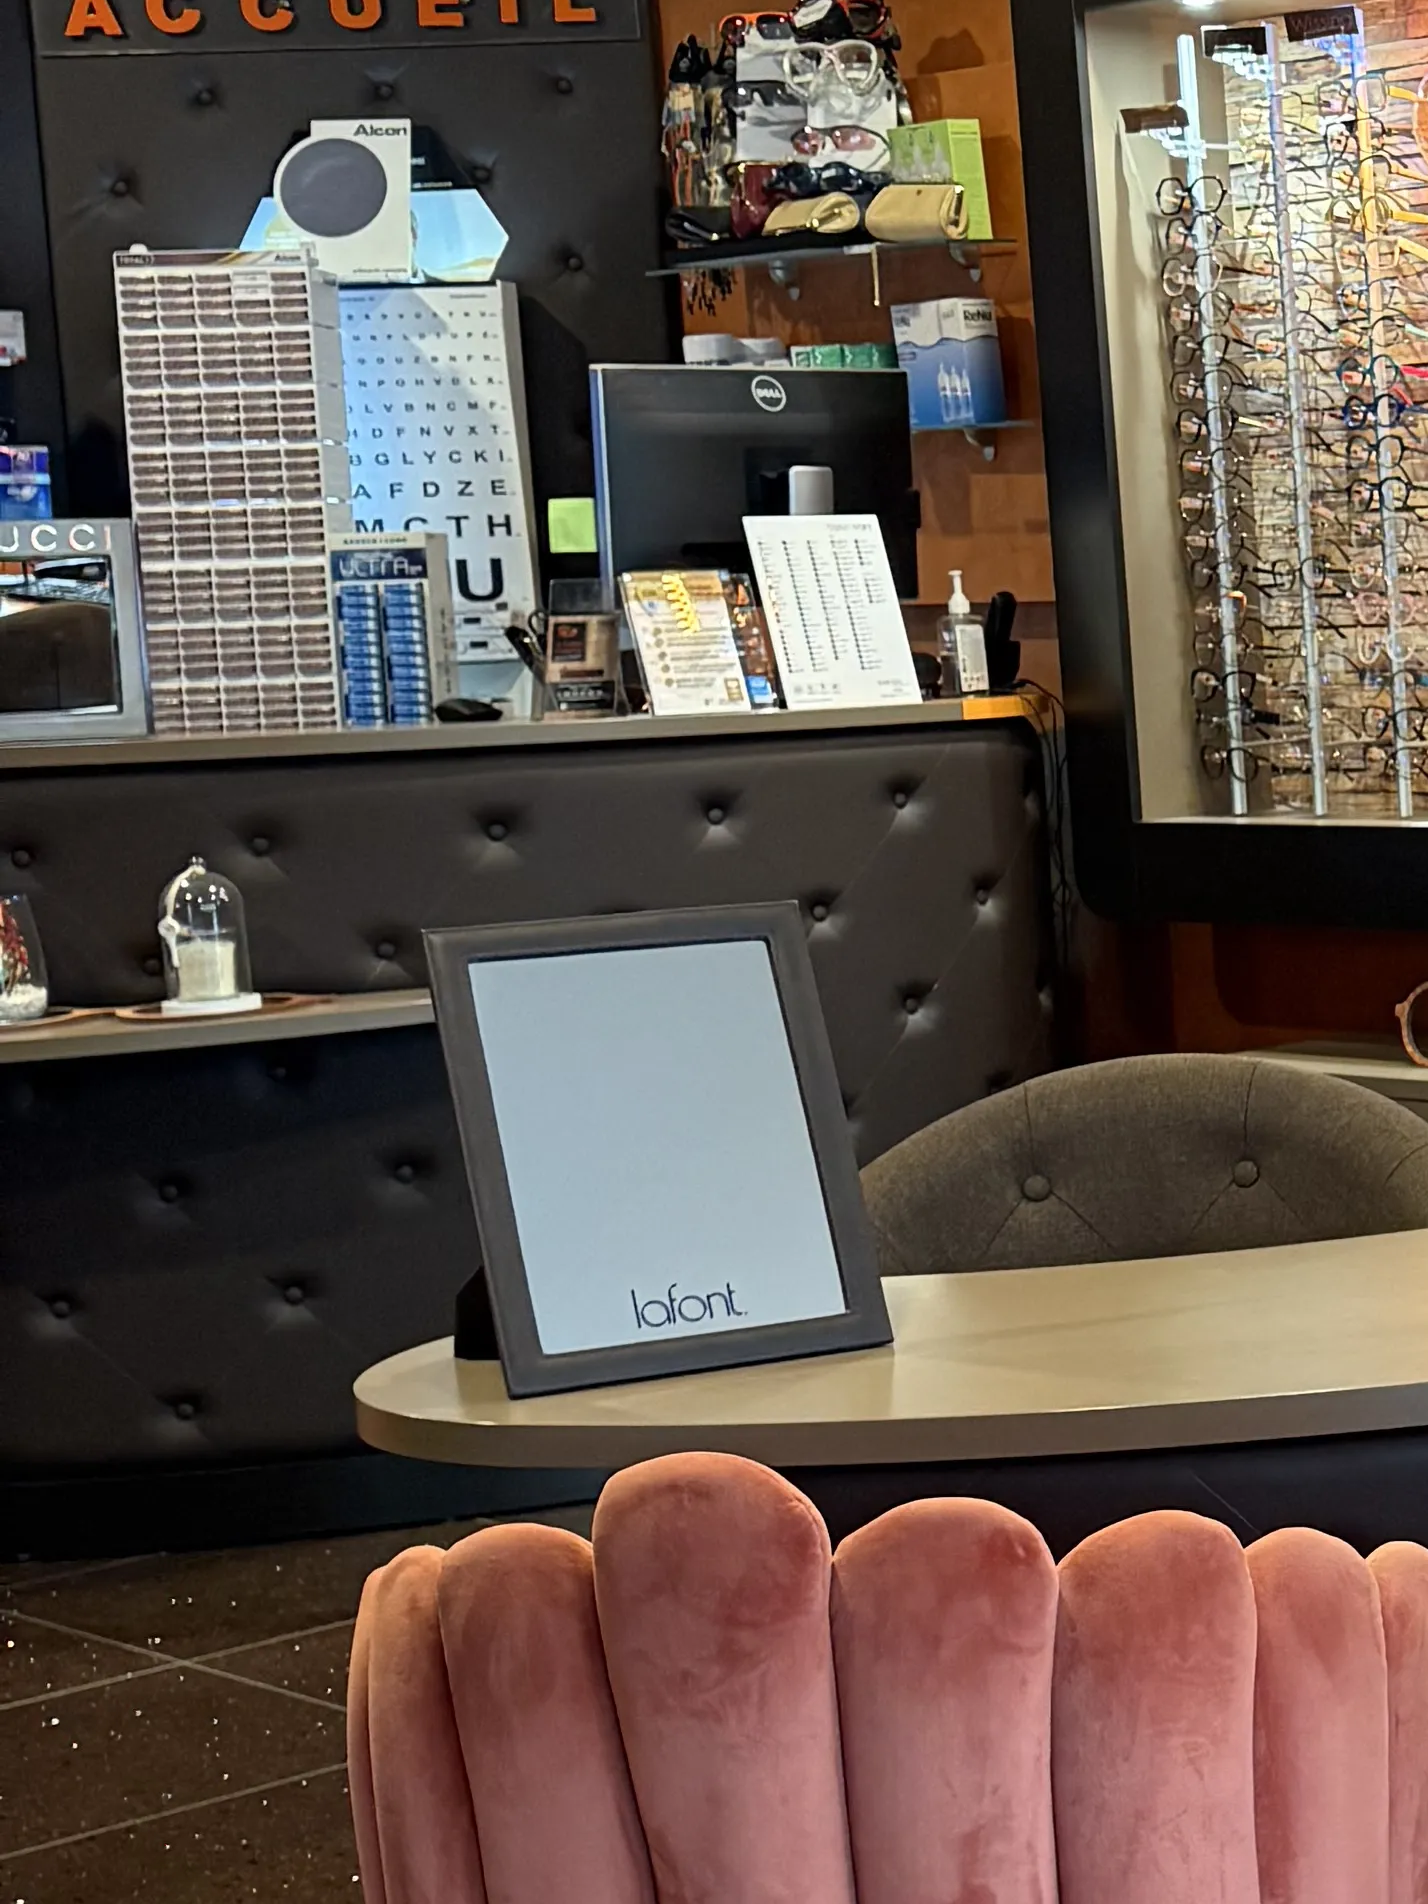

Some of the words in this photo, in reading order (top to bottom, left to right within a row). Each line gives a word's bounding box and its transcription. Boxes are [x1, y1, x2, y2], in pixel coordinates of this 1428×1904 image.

[353, 123, 407, 137] Alcon
[0, 523, 112, 553] UCCI
[455, 557, 505, 602] U
[631, 1282, 743, 1329] lafont
